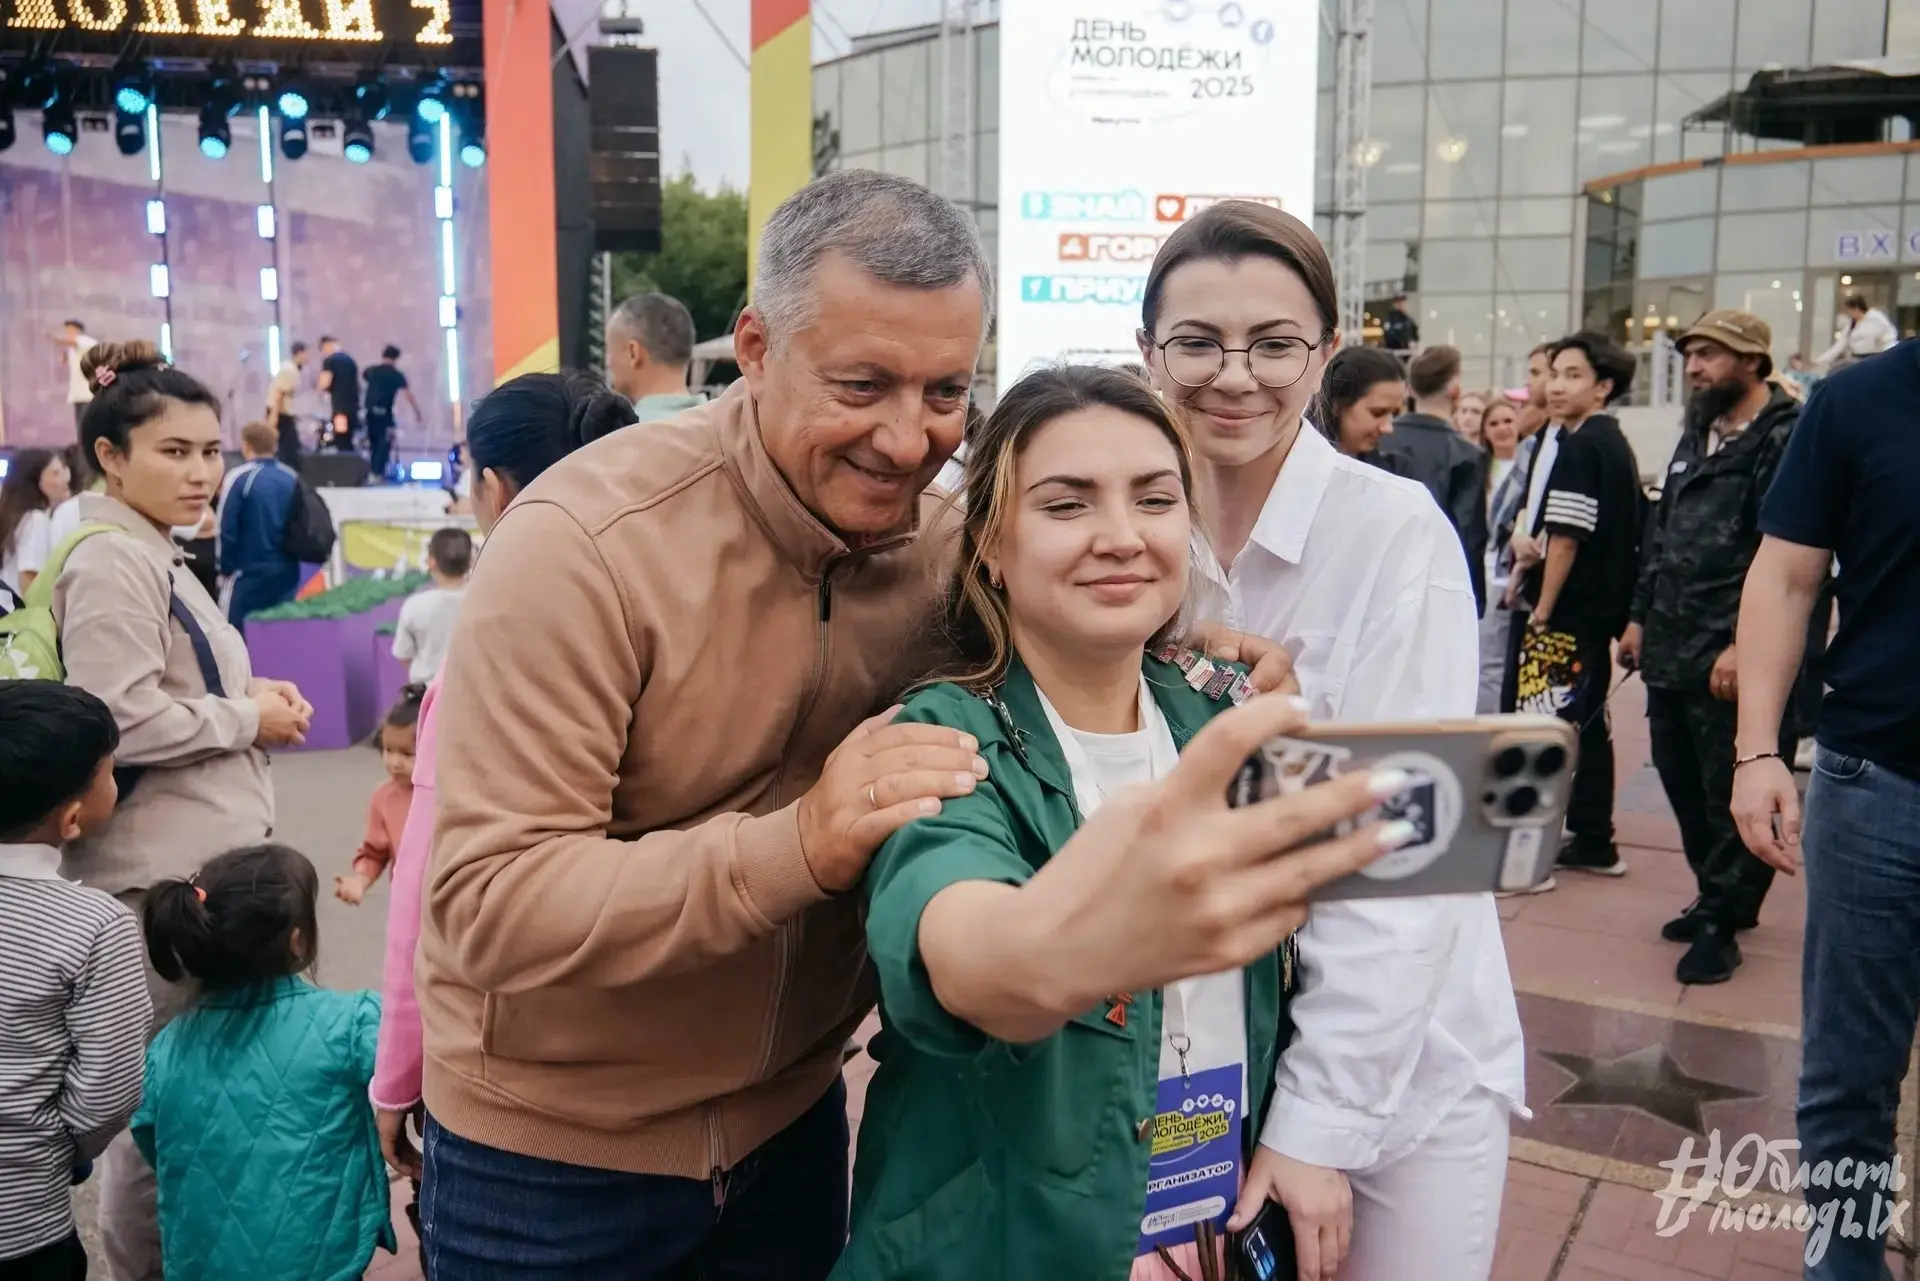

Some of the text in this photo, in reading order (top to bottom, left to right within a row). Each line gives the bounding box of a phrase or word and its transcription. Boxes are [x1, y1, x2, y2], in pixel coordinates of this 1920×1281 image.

[1070, 18, 1147, 42] ДЕНЬ
[1190, 75, 1255, 99] 2025
[1087, 234, 1166, 261] ГОР
[1050, 277, 1146, 304] ПРИУ
[1199, 1123, 1227, 1141] 2025
[1148, 1162, 1232, 1191] РГАНИЗАТОР
